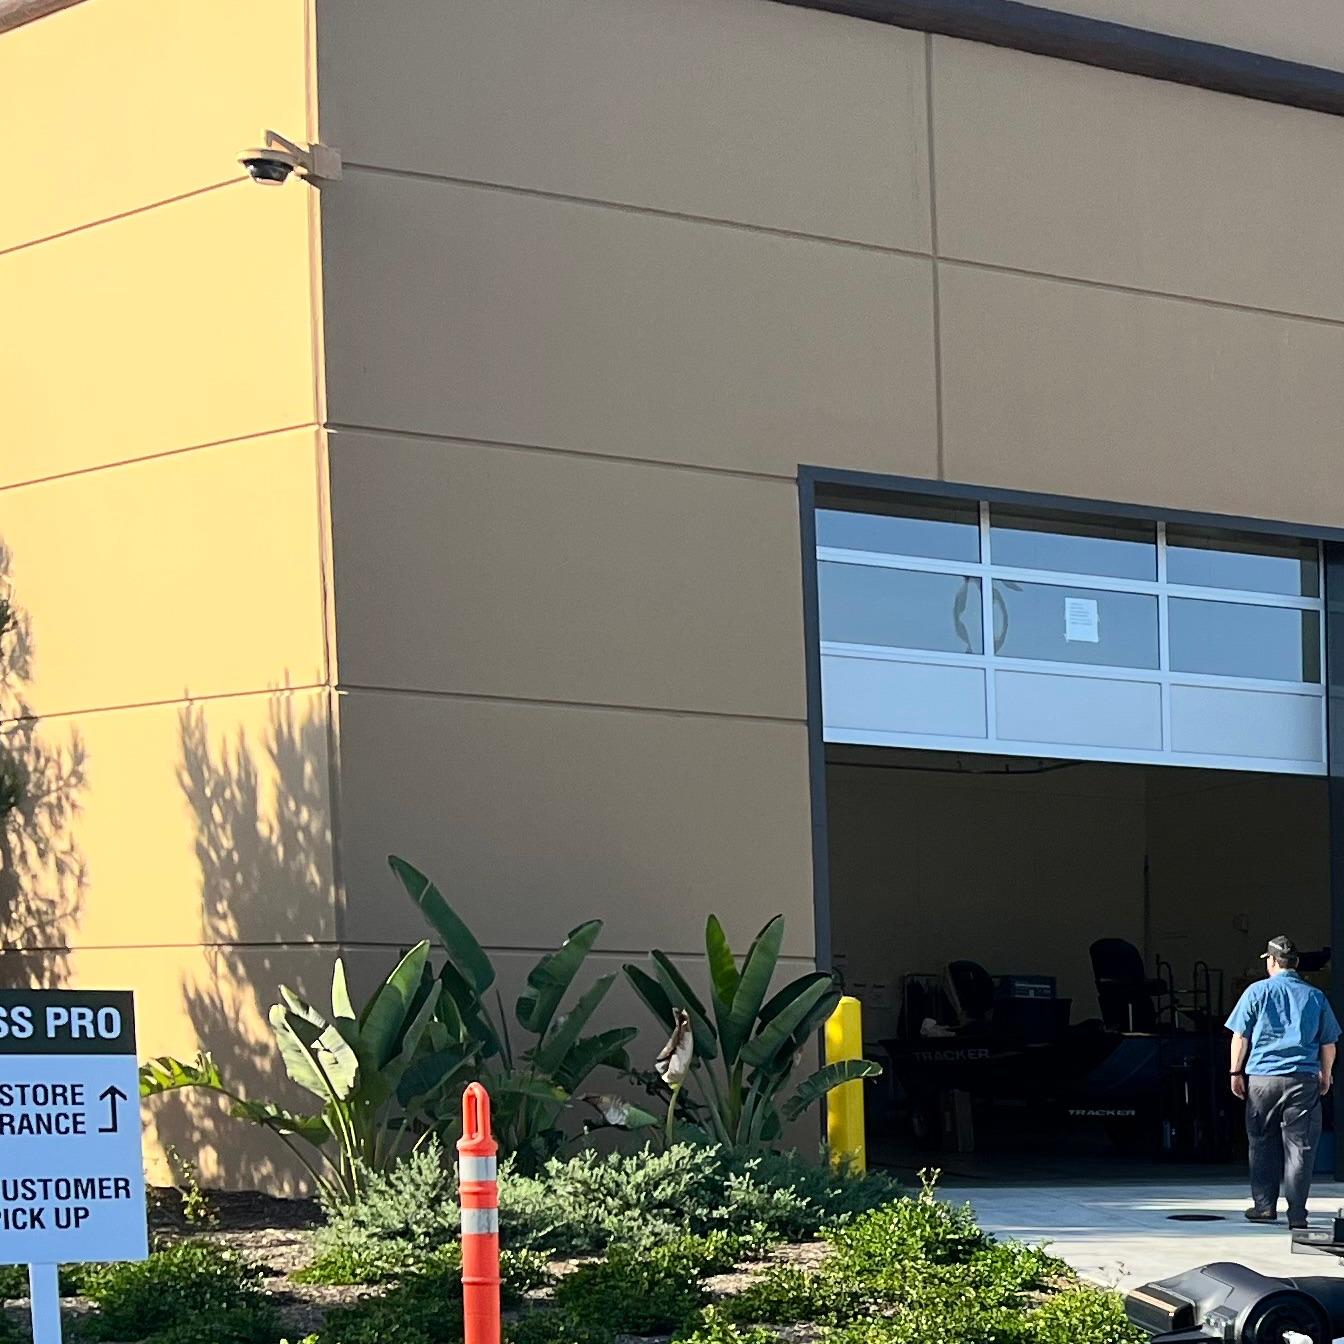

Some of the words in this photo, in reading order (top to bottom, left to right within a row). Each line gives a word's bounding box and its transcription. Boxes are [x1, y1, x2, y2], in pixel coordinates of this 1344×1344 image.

[46, 1006, 121, 1039] PRO
[0, 1083, 84, 1106] STORE
[1068, 1108, 1136, 1117] TRACKER
[2, 1178, 130, 1201] USTOMER
[0, 1207, 46, 1230] ICK
[54, 1206, 90, 1229] UP
